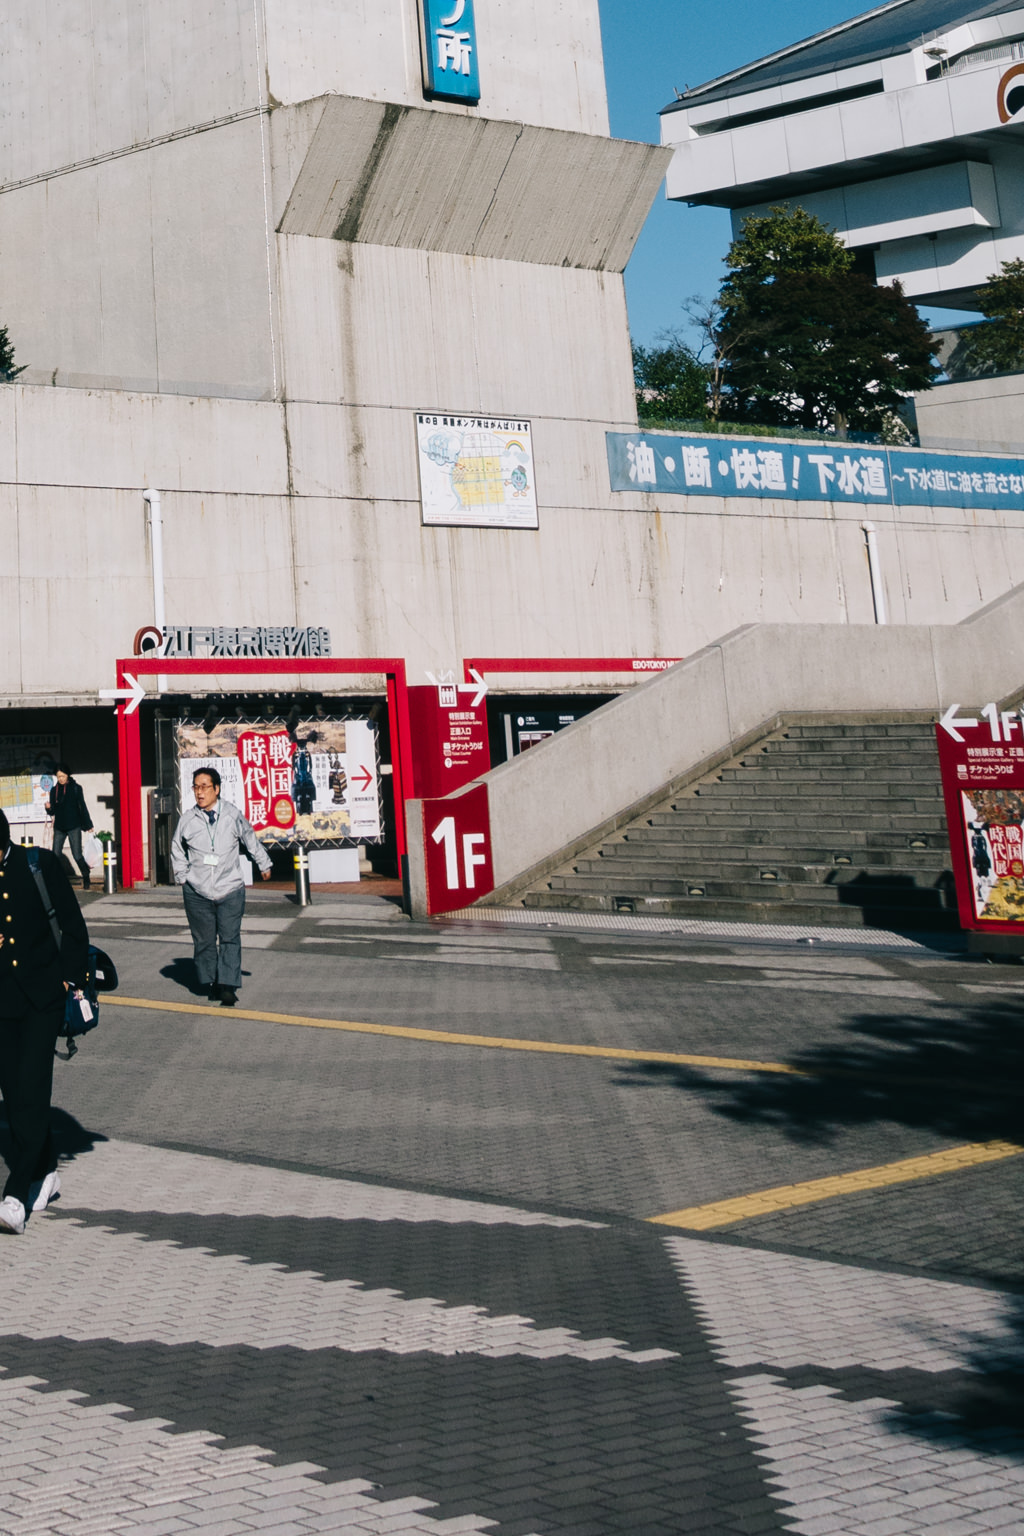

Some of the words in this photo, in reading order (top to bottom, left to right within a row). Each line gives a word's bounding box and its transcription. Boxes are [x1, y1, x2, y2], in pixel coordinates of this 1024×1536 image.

[163, 626, 331, 657] 江戸東京博物館
[981, 703, 1018, 742] 1F
[242, 735, 268, 827] 時代展
[268, 735, 294, 797] 戦国
[969, 765, 1014, 774] チケットうりば
[431, 817, 486, 889] 1F
